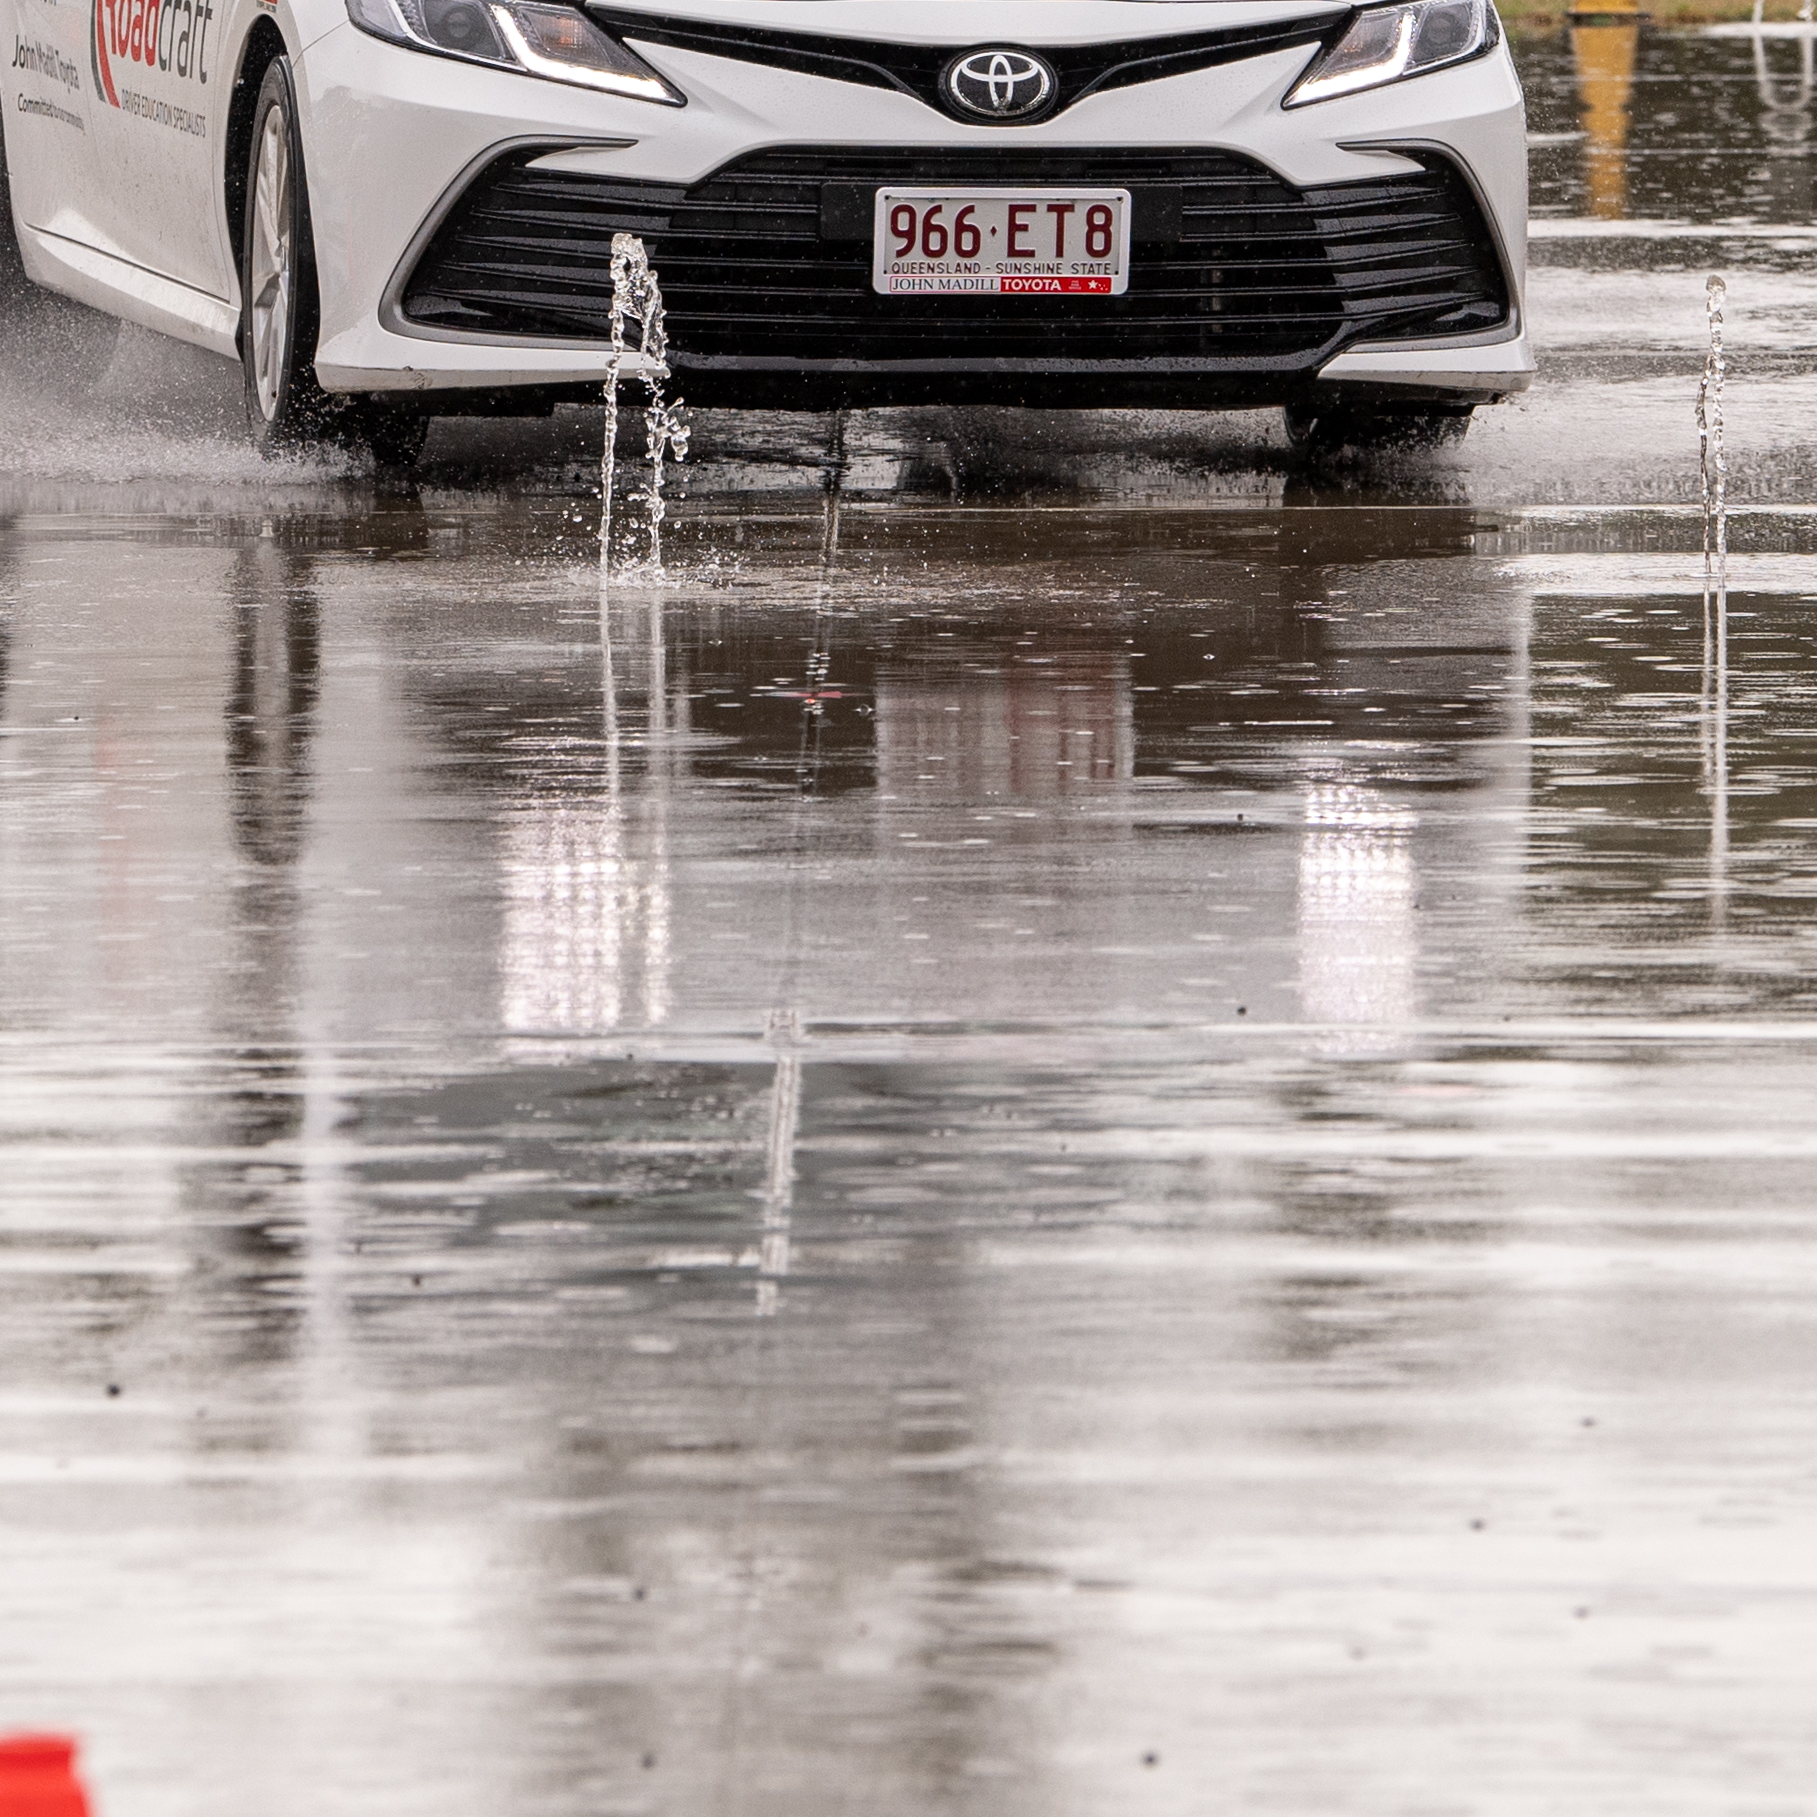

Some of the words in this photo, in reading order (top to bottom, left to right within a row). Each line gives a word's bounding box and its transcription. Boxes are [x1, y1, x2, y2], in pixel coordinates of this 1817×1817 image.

[121, 88, 141, 116] DRIVER
[891, 262, 981, 275] QUEENSLAND
[996, 262, 1063, 275] SUNSHINE
[1070, 262, 1112, 275] STATE
[892, 278, 934, 291] JOHN
[937, 278, 999, 291] MADILL
[1002, 278, 1062, 291] TOYOTA
